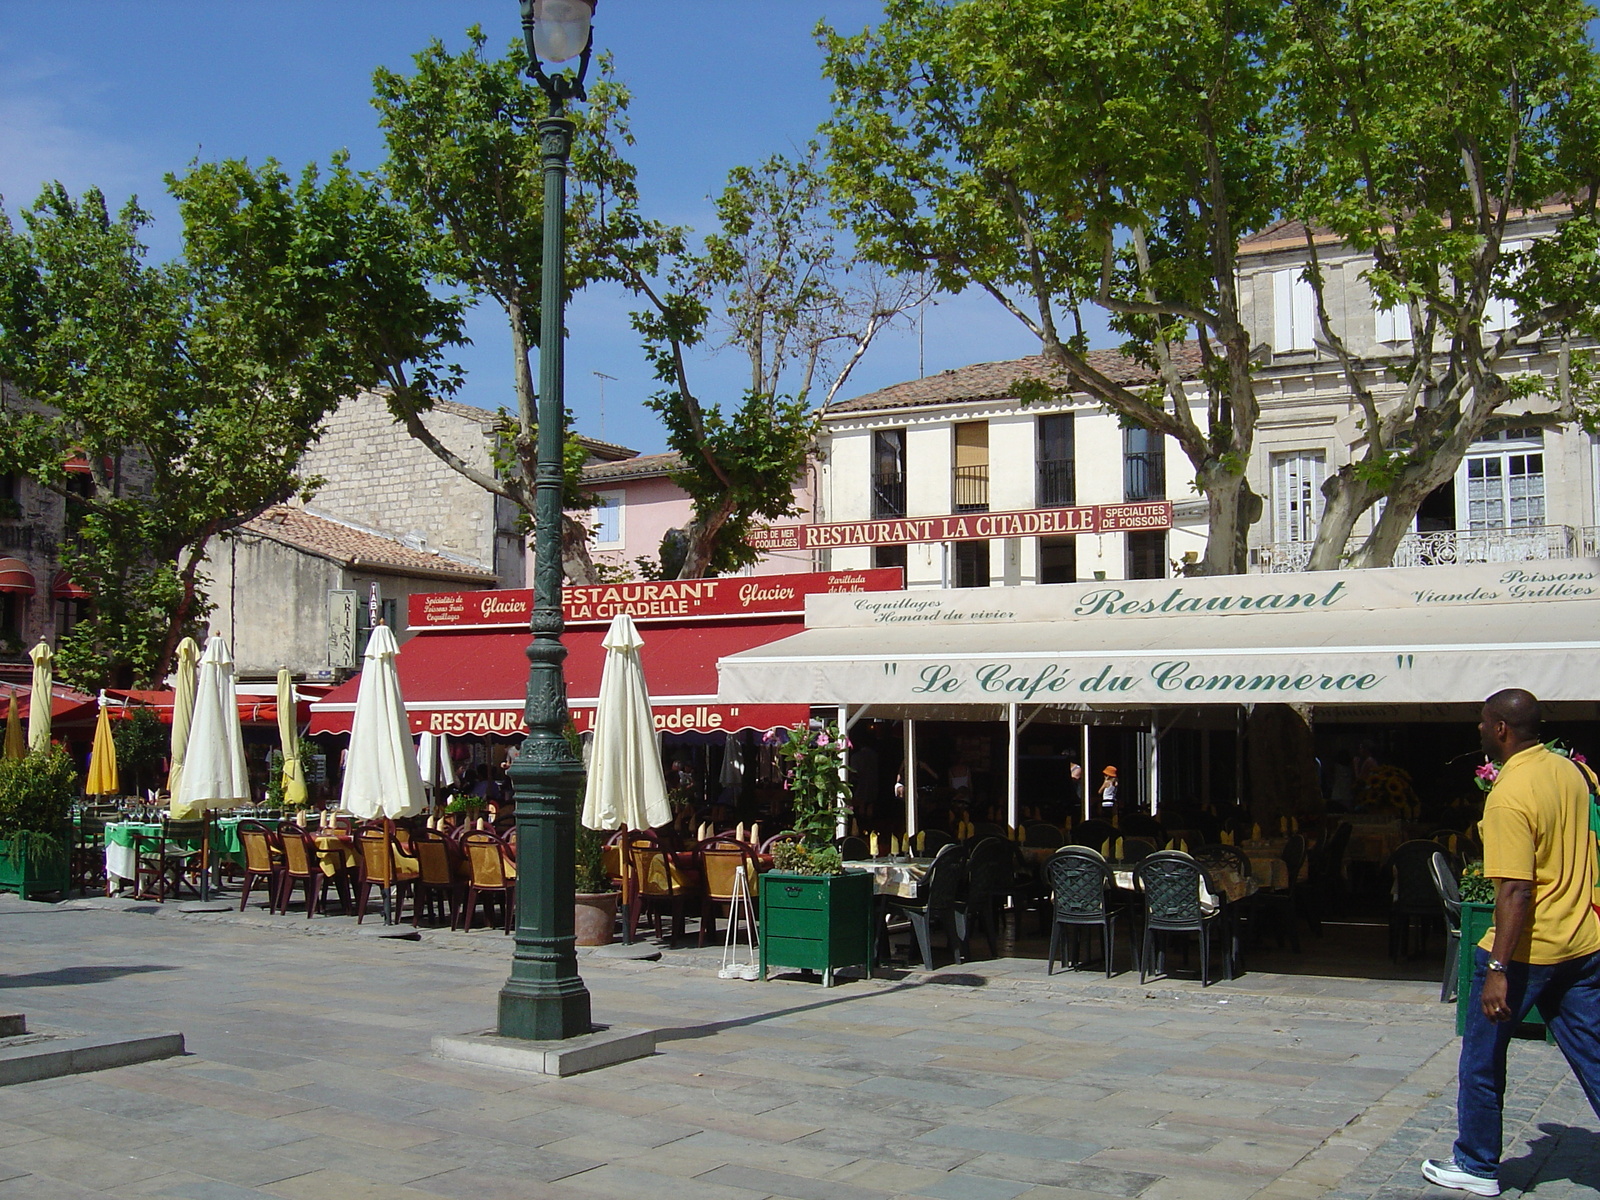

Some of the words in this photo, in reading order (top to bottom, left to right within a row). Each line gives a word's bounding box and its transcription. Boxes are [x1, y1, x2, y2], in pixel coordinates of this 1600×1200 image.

[1105, 505, 1165, 518] SPECIALITES
[806, 520, 934, 546] RESTAURANT
[942, 518, 969, 538] LA
[976, 510, 1094, 536] CITADELLE
[1102, 519, 1116, 529] DE
[1119, 515, 1168, 528] POISSONS
[755, 538, 798, 548] COQUILLAGES
[770, 530, 779, 539] DE
[781, 529, 795, 538] MER
[1500, 570, 1598, 584] Poissons
[456, 595, 463, 603] de
[561, 582, 719, 605] ESTAURANT
[738, 583, 795, 607] Glacier
[1075, 581, 1348, 616] Restaurant
[1411, 587, 1502, 603] Viandes
[1509, 583, 1597, 599] Grillées
[481, 596, 526, 618] Glacier
[571, 604, 592, 618] LA
[597, 600, 689, 617] CITADELLE
[854, 599, 943, 613] Coquillages
[874, 610, 941, 623] Homard
[943, 609, 964, 620] du
[970, 610, 1017, 620] vivier
[912, 664, 967, 693] Le
[976, 663, 1075, 700] Café
[1080, 664, 1143, 692] du
[1150, 660, 1387, 691] Commerce
[430, 712, 528, 731] RESTAUR
[653, 707, 722, 728] adelle
